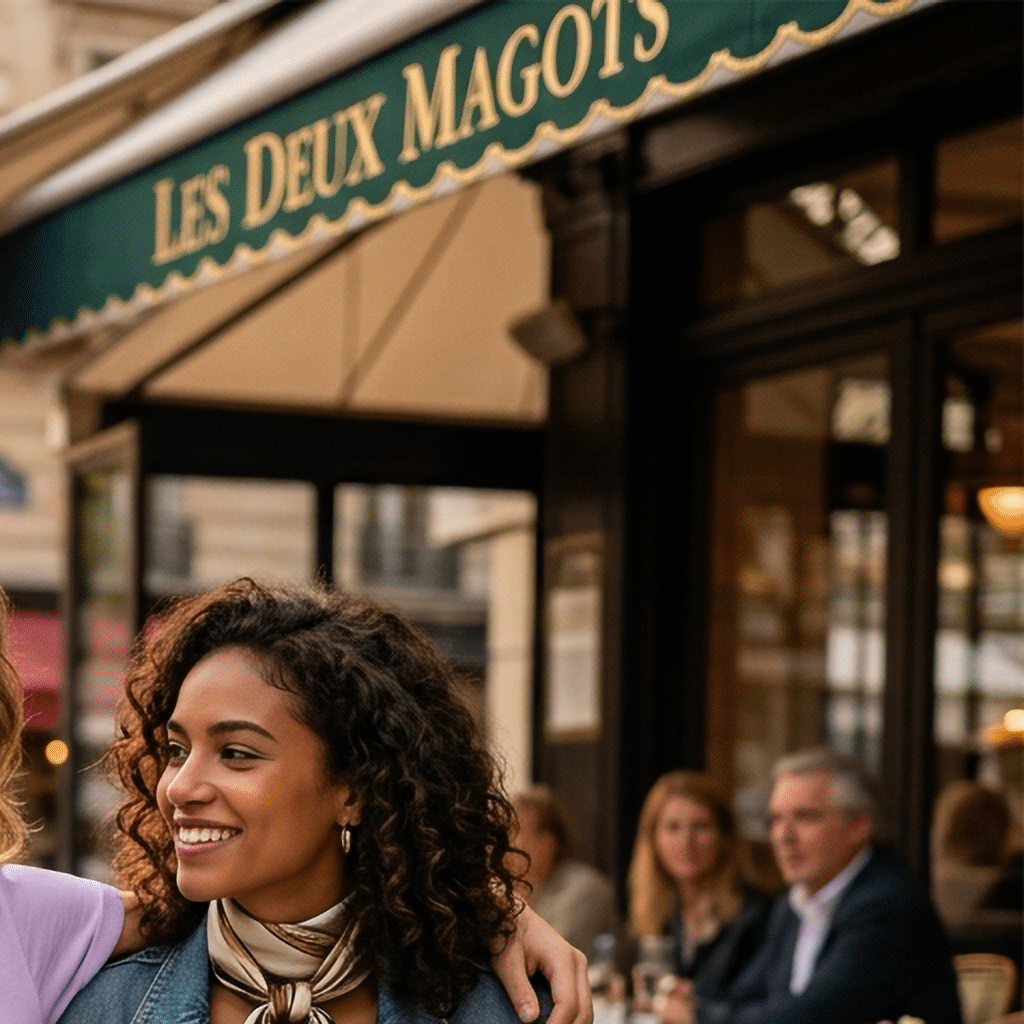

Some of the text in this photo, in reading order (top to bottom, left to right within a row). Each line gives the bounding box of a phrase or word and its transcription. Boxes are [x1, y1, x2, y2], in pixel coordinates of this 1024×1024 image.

[151, 0, 669, 265] LES DEUX MAGOTS
